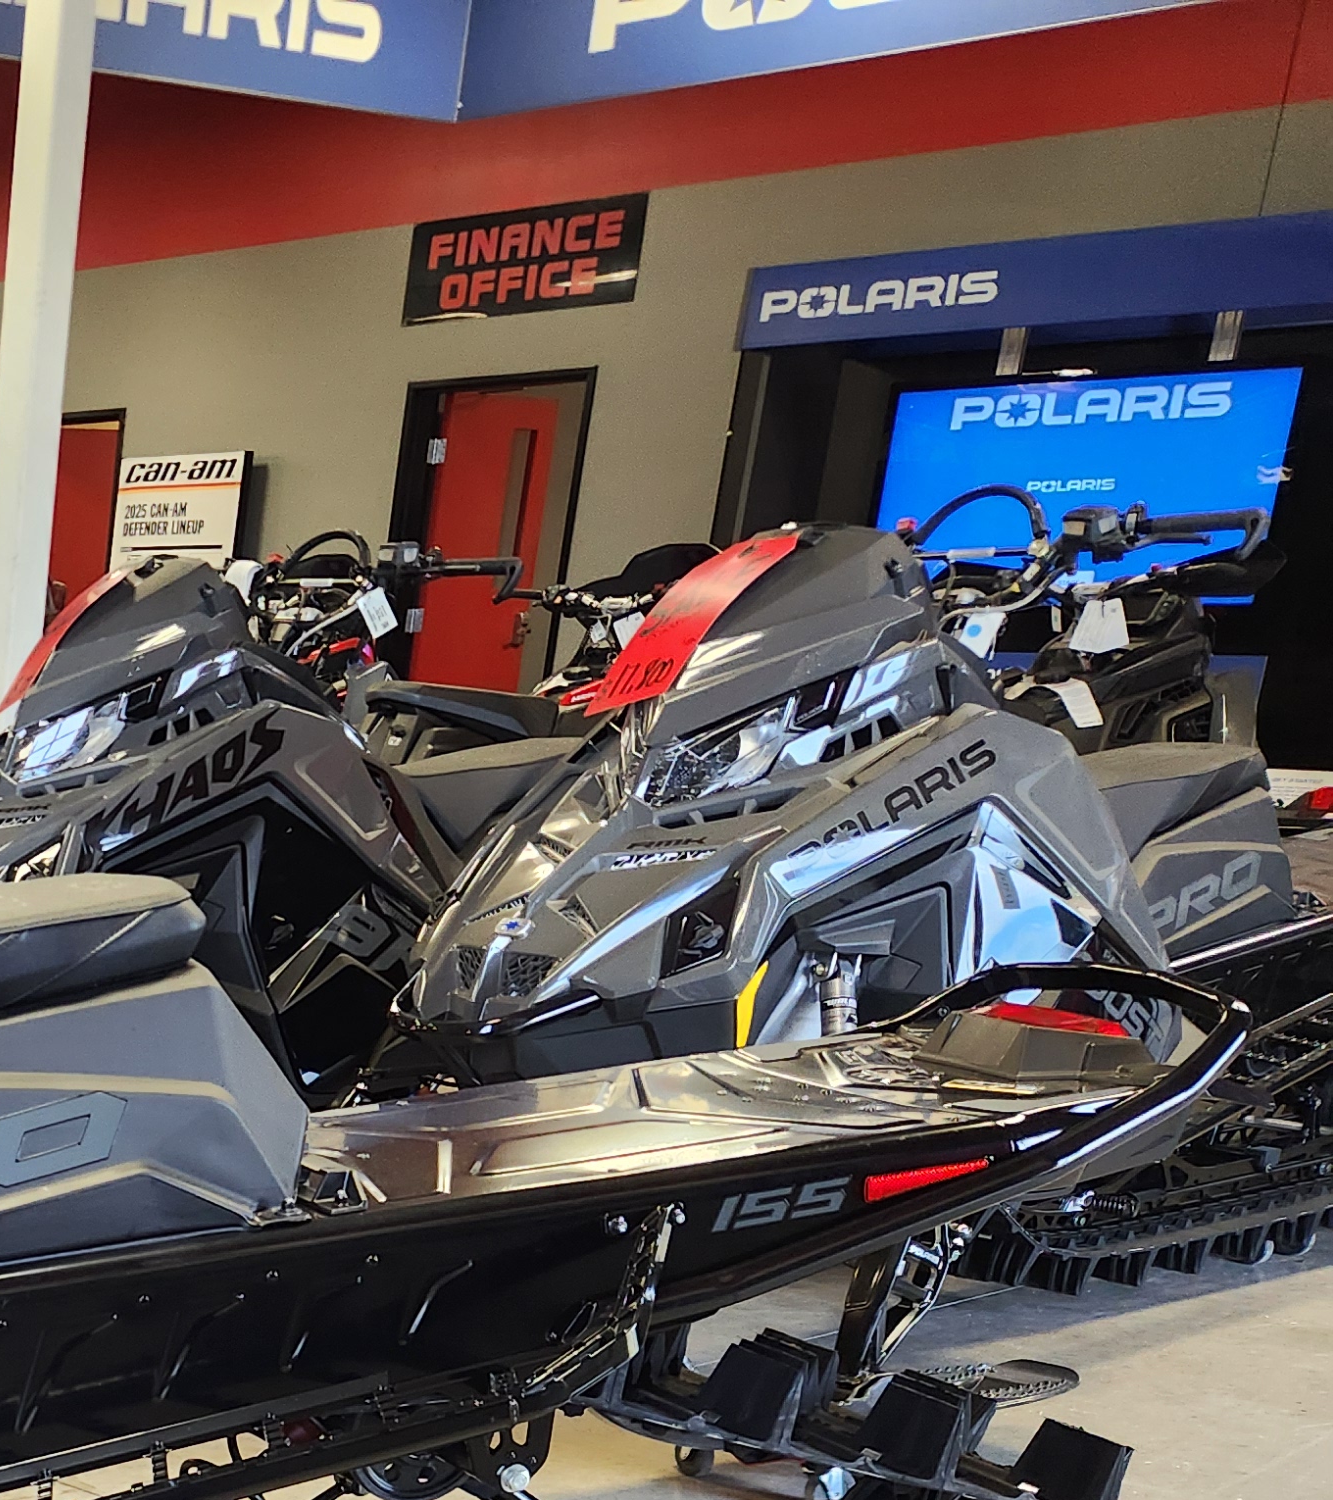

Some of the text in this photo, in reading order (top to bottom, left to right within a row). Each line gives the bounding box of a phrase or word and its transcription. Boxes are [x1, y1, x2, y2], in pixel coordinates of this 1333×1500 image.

[427, 209, 626, 270] FINANCE
[439, 256, 599, 310] OFFICE
[759, 270, 999, 323] POLARIS
[949, 381, 1232, 430] POLARIS
[125, 458, 237, 483] can-am
[1026, 477, 1116, 493] POLARIS
[123, 520, 204, 537] DEFENDER LINEUP
[124, 502, 187, 519] 2025 CAN-AM
[84, 708, 285, 850] KHAOS
[1149, 850, 1262, 930] PRO
[711, 1175, 852, 1232] 155
